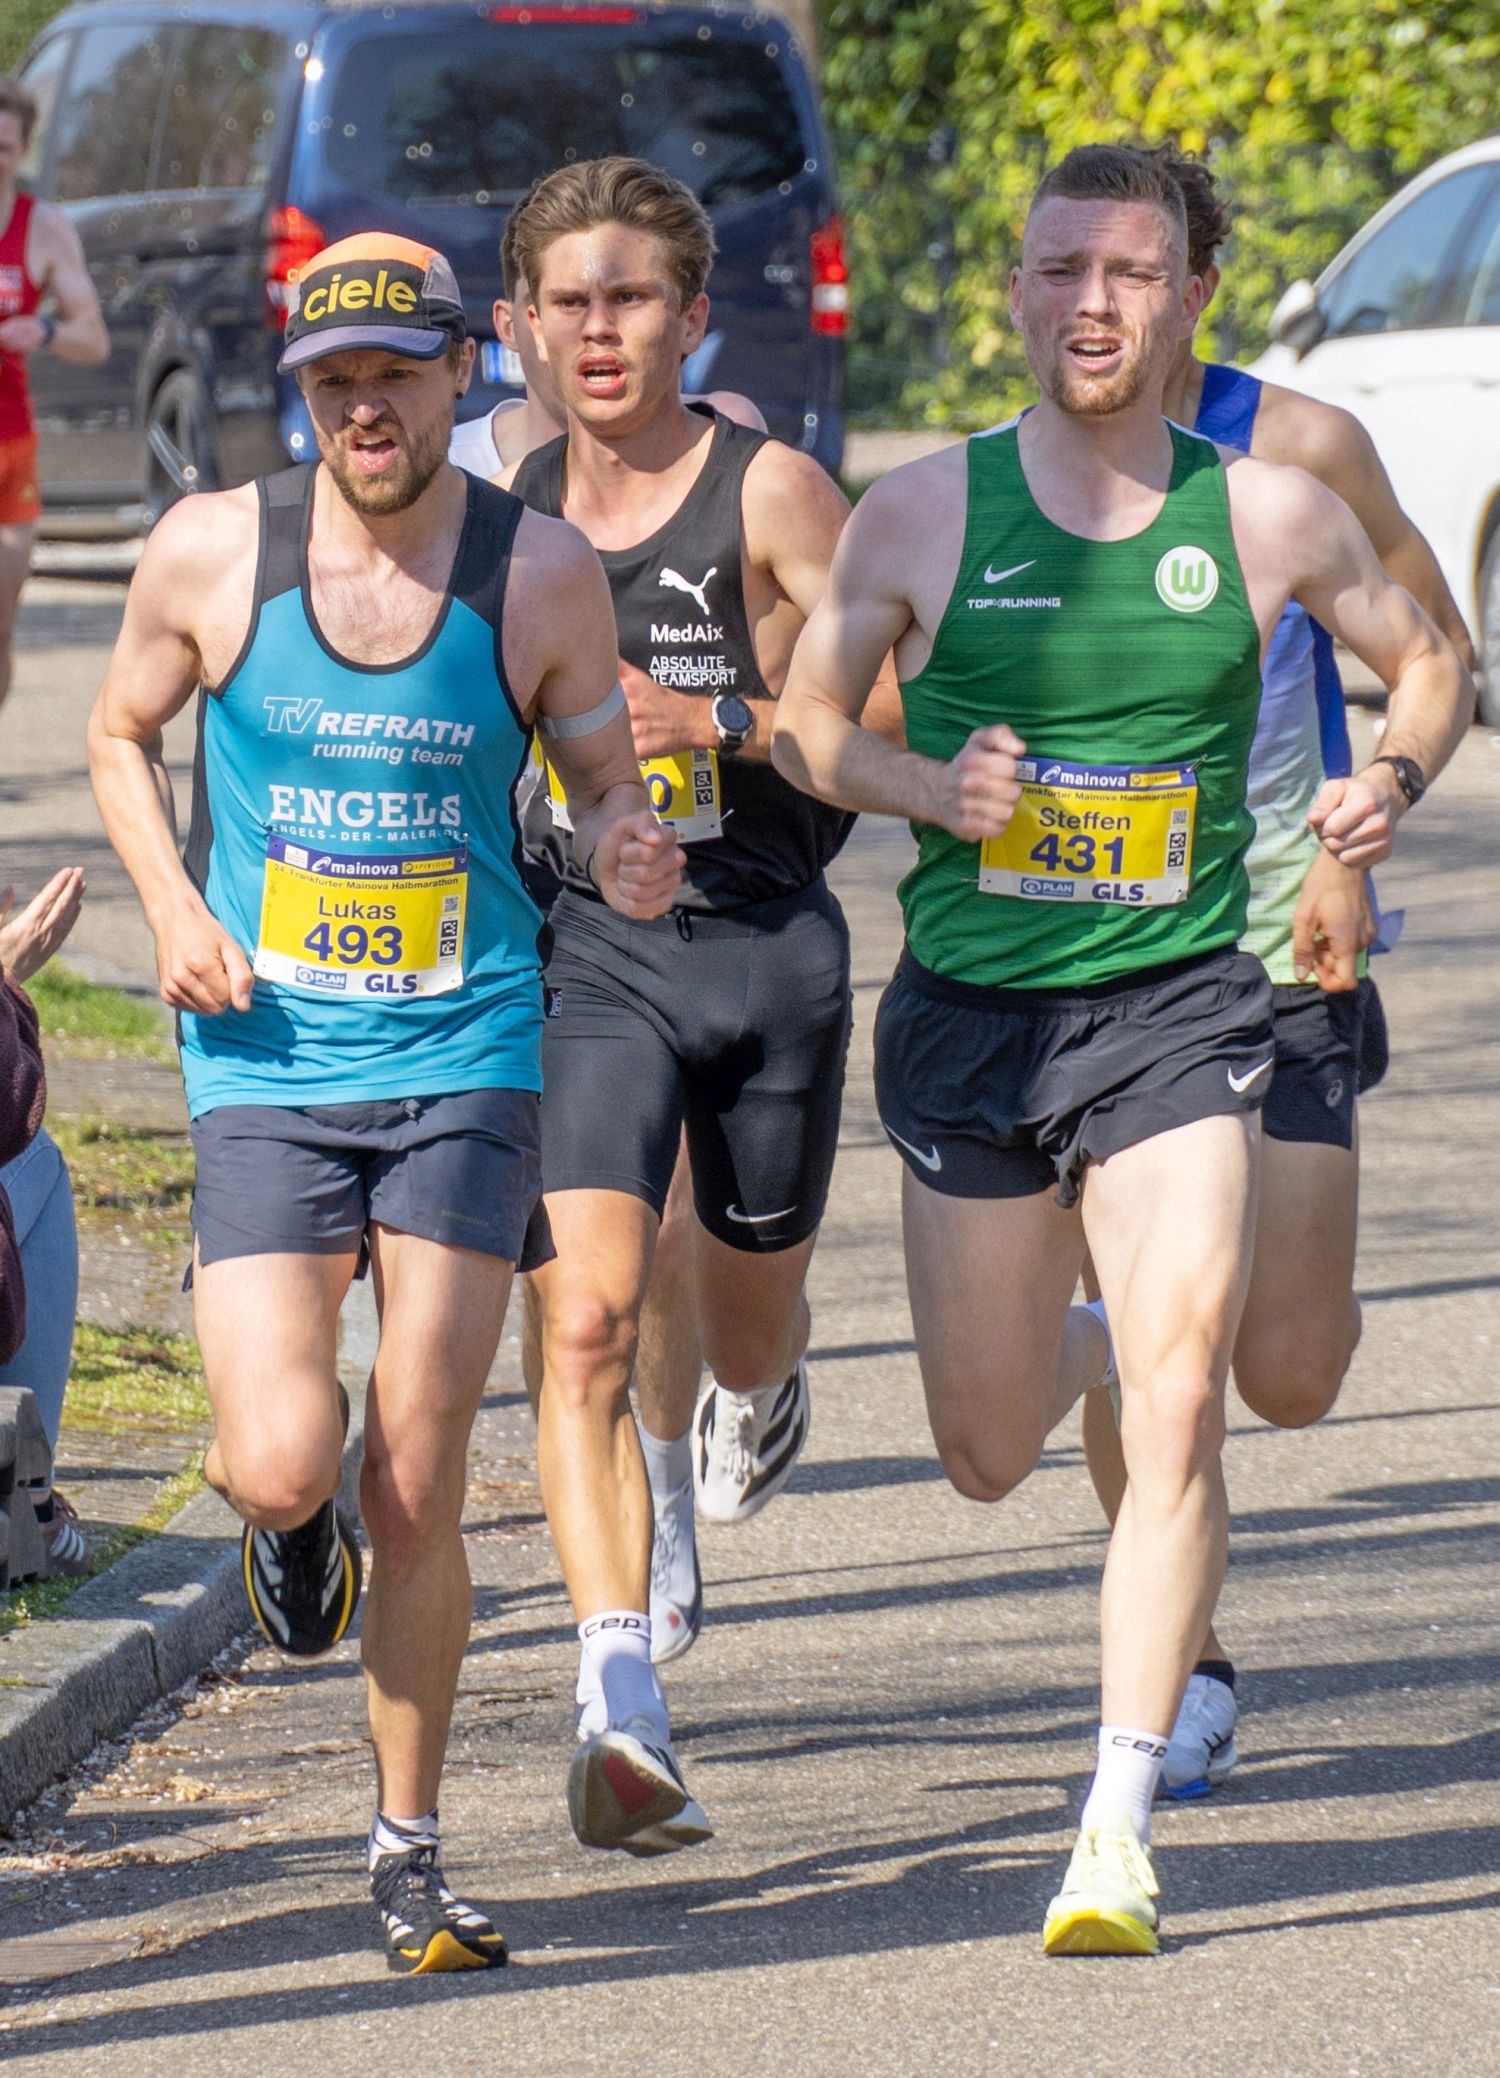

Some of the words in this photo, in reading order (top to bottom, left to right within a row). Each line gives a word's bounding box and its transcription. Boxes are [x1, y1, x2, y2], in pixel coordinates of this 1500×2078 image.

[304, 270, 417, 321] ciele
[650, 623, 723, 643] MedAix
[650, 655, 725, 670] ABSOLUTE
[650, 671, 736, 687] TEAMSPORT
[263, 696, 323, 734] TV
[317, 711, 475, 747] REFRATH
[313, 741, 404, 765] running
[411, 746, 464, 766] team
[1060, 771, 1127, 787] mainova
[1022, 786, 1072, 799] rankfurter
[1075, 792, 1117, 801] Mainova
[1120, 790, 1188, 801] Halbmarathon
[268, 784, 461, 828] ENGELS
[1039, 807, 1131, 830] Steffen
[1030, 833, 1124, 875] 431
[331, 861, 399, 875] mainova
[290, 869, 343, 889] Frankfurter
[347, 882, 389, 890] Mainova
[392, 877, 459, 890] Halbmarathon
[1042, 881, 1073, 893] PLAN
[319, 896, 397, 920] Lukas
[304, 922, 403, 966] 493
[315, 974, 345, 985] PLAN
[584, 1617, 641, 1638] cep
